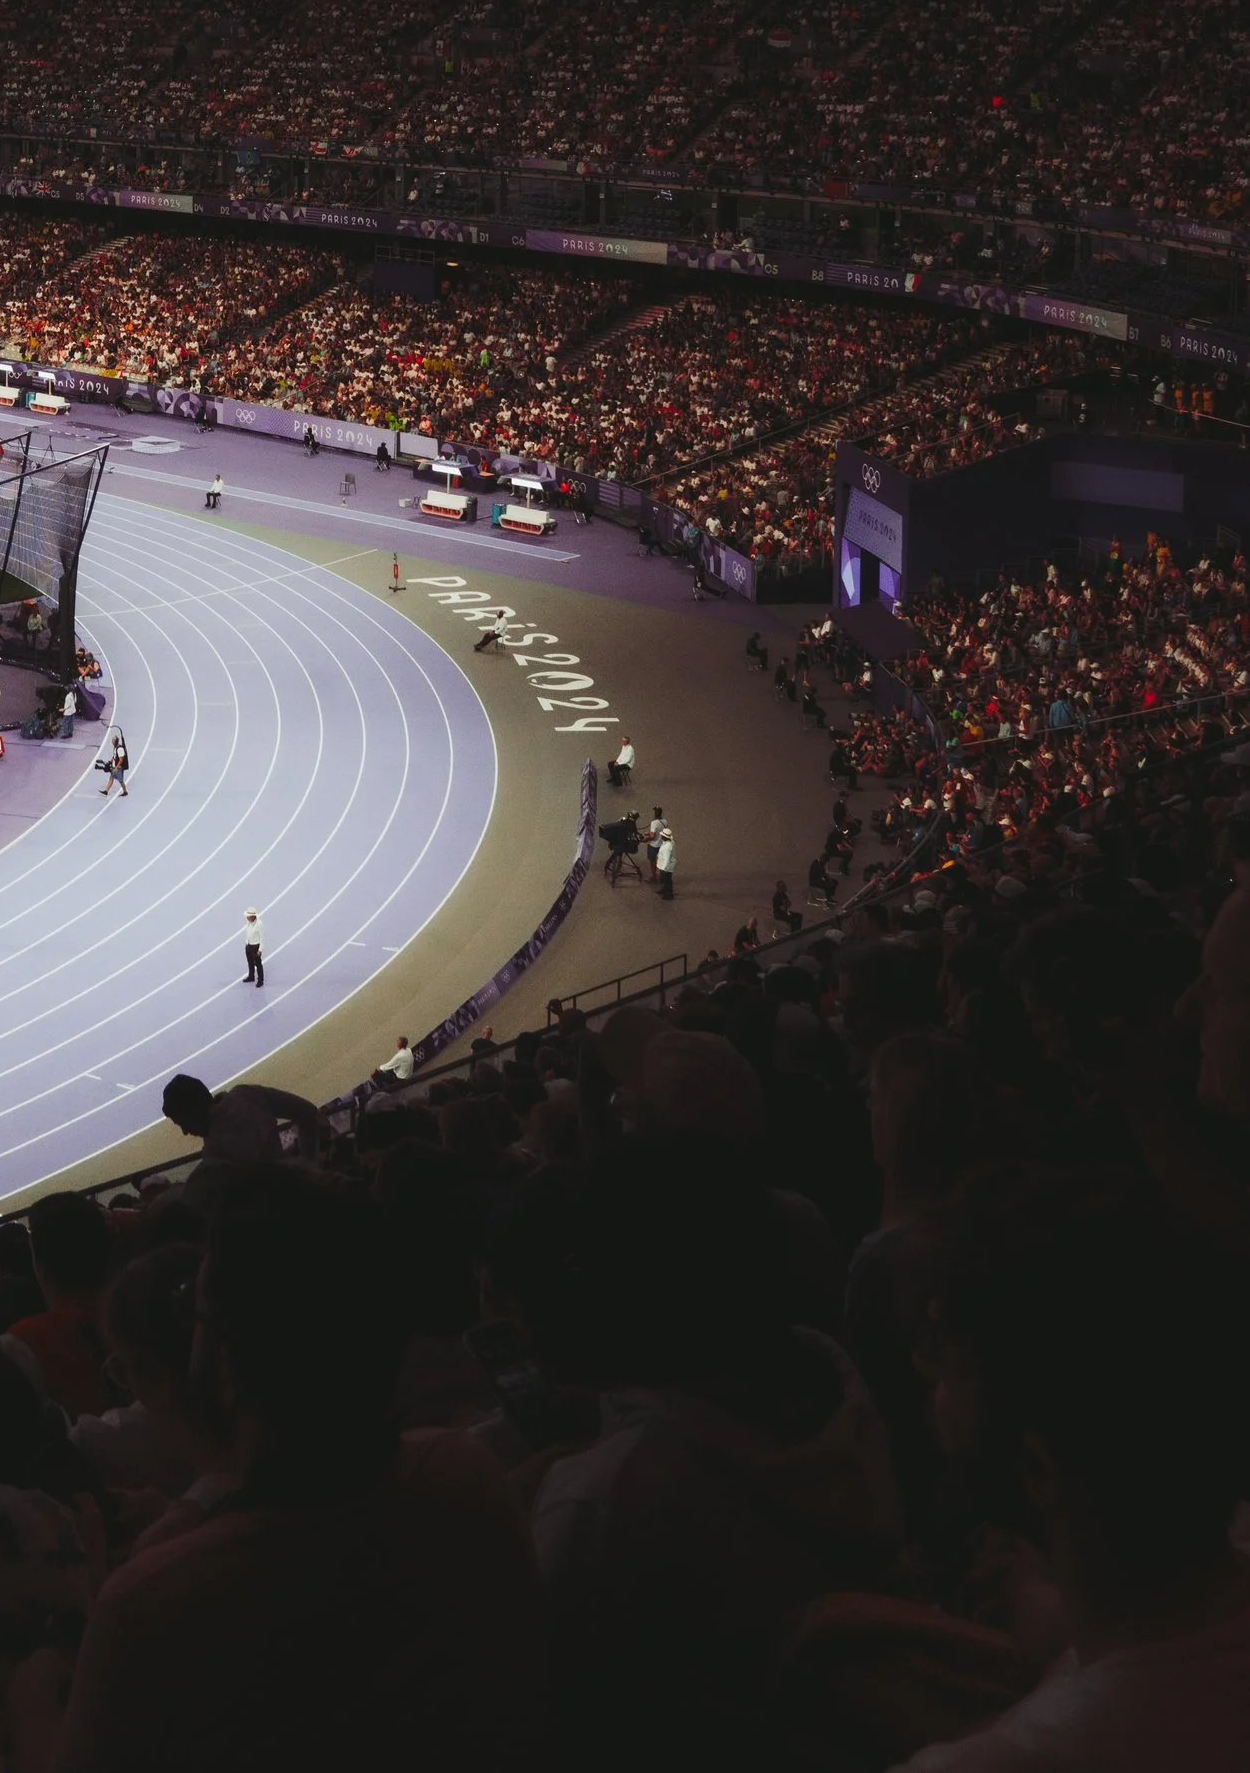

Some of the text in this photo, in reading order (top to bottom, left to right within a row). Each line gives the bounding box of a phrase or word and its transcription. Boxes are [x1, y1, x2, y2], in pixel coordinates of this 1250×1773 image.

[131, 195, 181, 208] PARIS 2024
[220, 206, 230, 215] D2
[321, 214, 378, 228] PARIS 2024
[479, 232, 489, 242] D1
[562, 239, 628, 254] PARIS 2024
[764, 263, 778, 275] C5
[811, 269, 824, 282] B8
[847, 271, 879, 287] PARIS
[1043, 305, 1108, 328] PARIS 2024
[1129, 326, 1139, 339] B7
[1160, 334, 1172, 349] B6
[1180, 336, 1239, 363] PARIS 2024
[79, 379, 109, 395] 2024
[337, 429, 373, 447] 2024
[858, 510, 878, 531] PARIS
